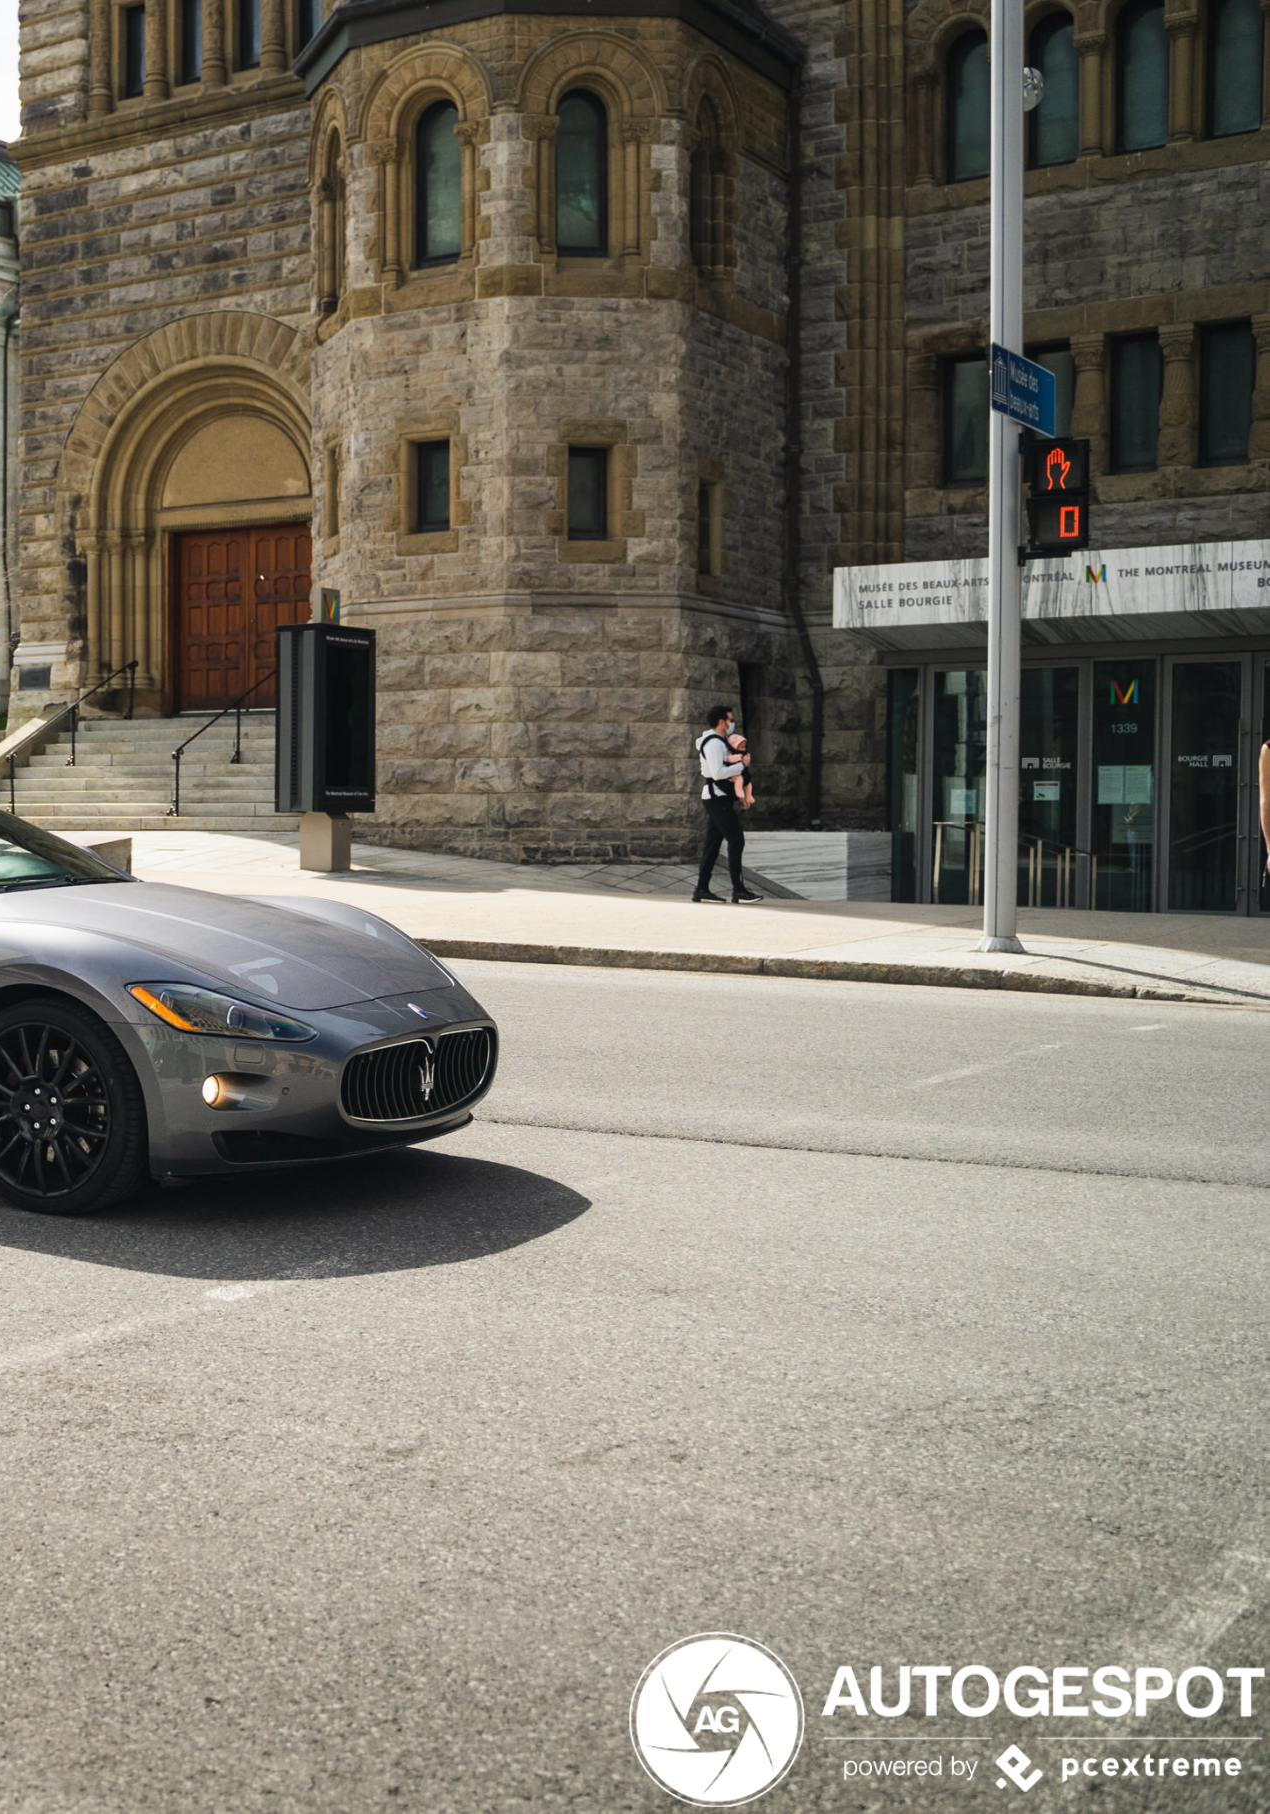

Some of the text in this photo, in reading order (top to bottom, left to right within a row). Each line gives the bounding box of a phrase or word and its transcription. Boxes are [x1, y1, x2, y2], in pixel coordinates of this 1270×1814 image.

[1010, 359, 1038, 393] Musée des
[1010, 389, 1039, 421] beaux-arts
[1060, 506, 1079, 537] 0
[1118, 560, 1270, 578] THE MONTREAL MUSEUM
[859, 571, 1075, 593] MUSÉE DES BEAUX-ARTS ONTRÉAL
[858, 596, 953, 610] SALLE BOURGIE
[1110, 723, 1138, 734] 1339
